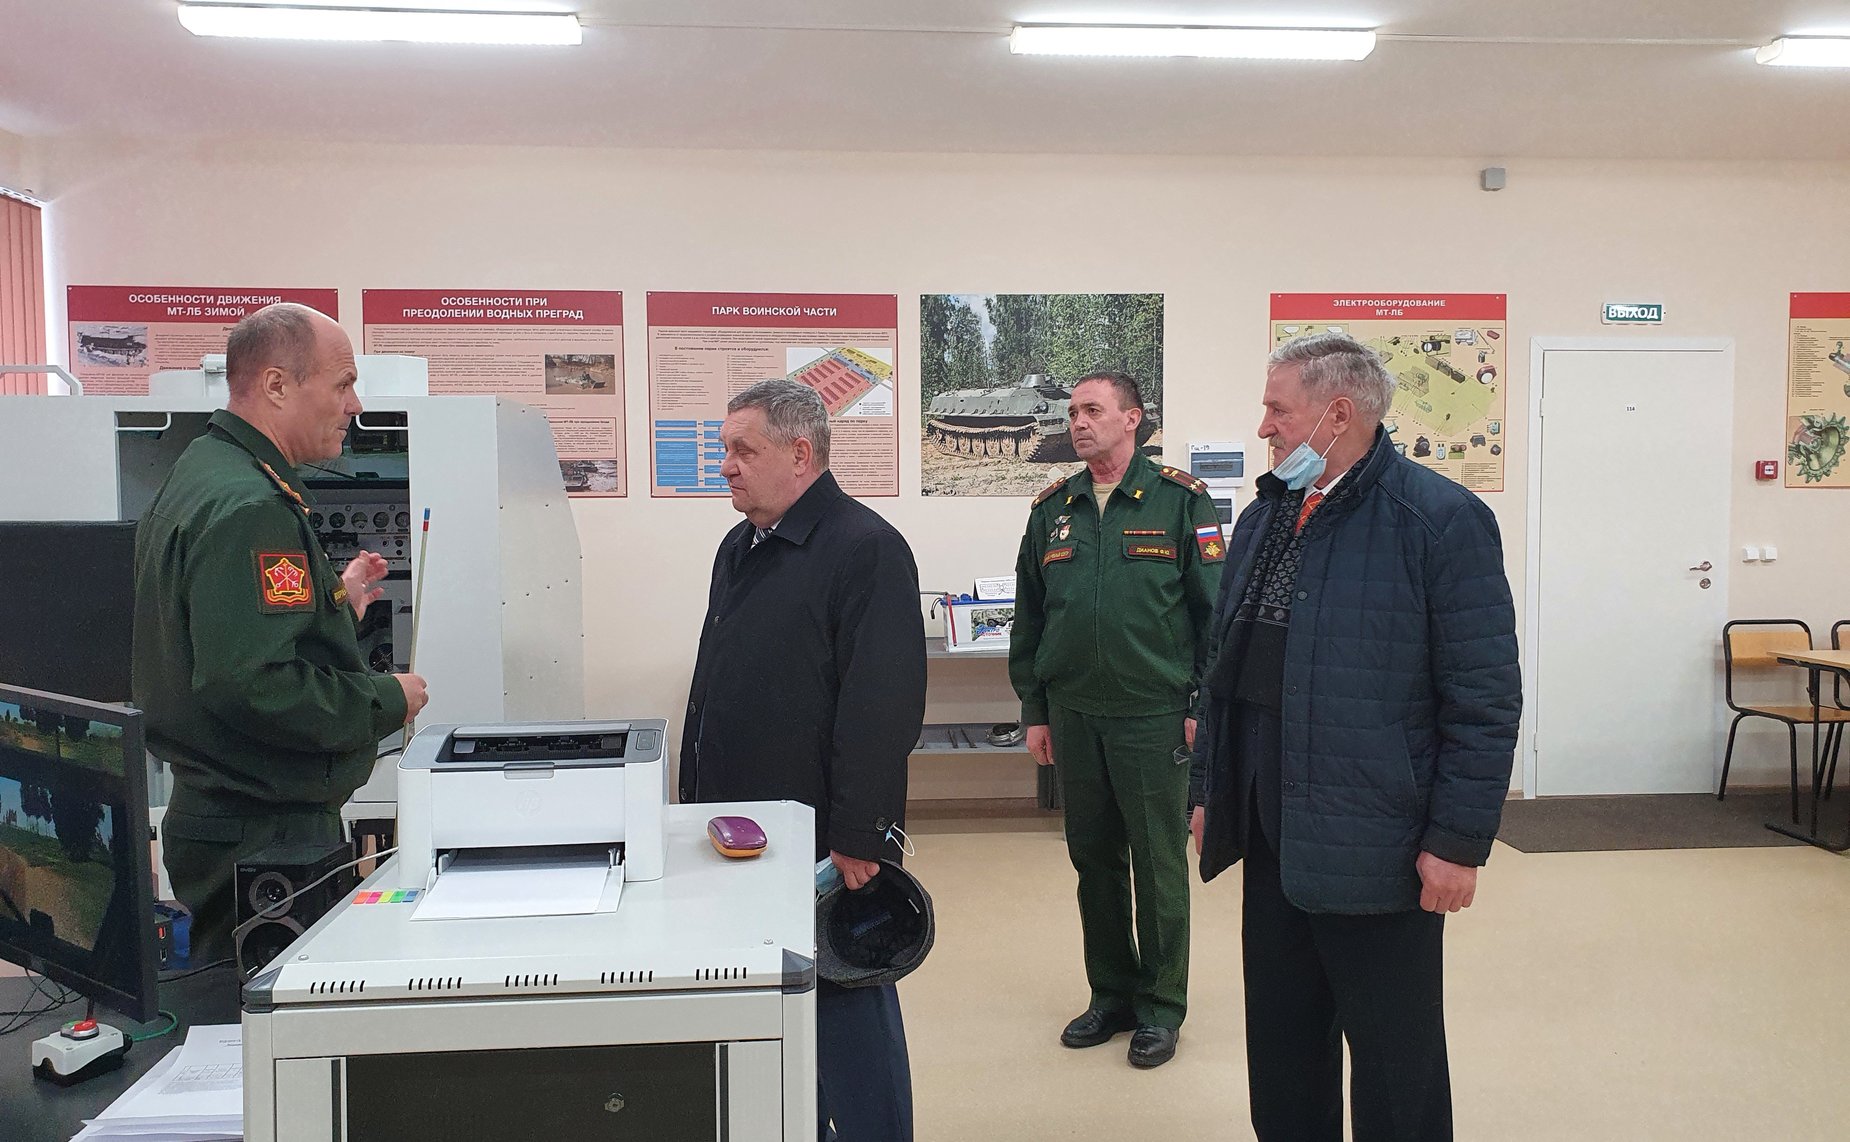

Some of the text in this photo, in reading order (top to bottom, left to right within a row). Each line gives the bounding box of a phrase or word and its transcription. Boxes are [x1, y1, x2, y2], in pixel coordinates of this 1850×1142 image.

[128, 294, 282, 305] ОСОБЕННОСТИ ДВИЖЕНИЯ
[441, 297, 547, 306] ОСОБЕННОСТИ ПРИ
[1333, 299, 1446, 308] ЭЛЕКТРООБОРУДОВАНИЕ
[167, 305, 245, 316] МТ-ЛБ ЗИМОЙ
[403, 308, 584, 320] ПРЕОДОЛЕНИИ ВОДНЫХ ПРЕГРАД
[712, 305, 837, 316] ПАРК ВОИНСКОЙ ЧАСТИ
[1375, 308, 1404, 317] МТ-ЛБ
[1608, 305, 1659, 320] ВЫХОД
